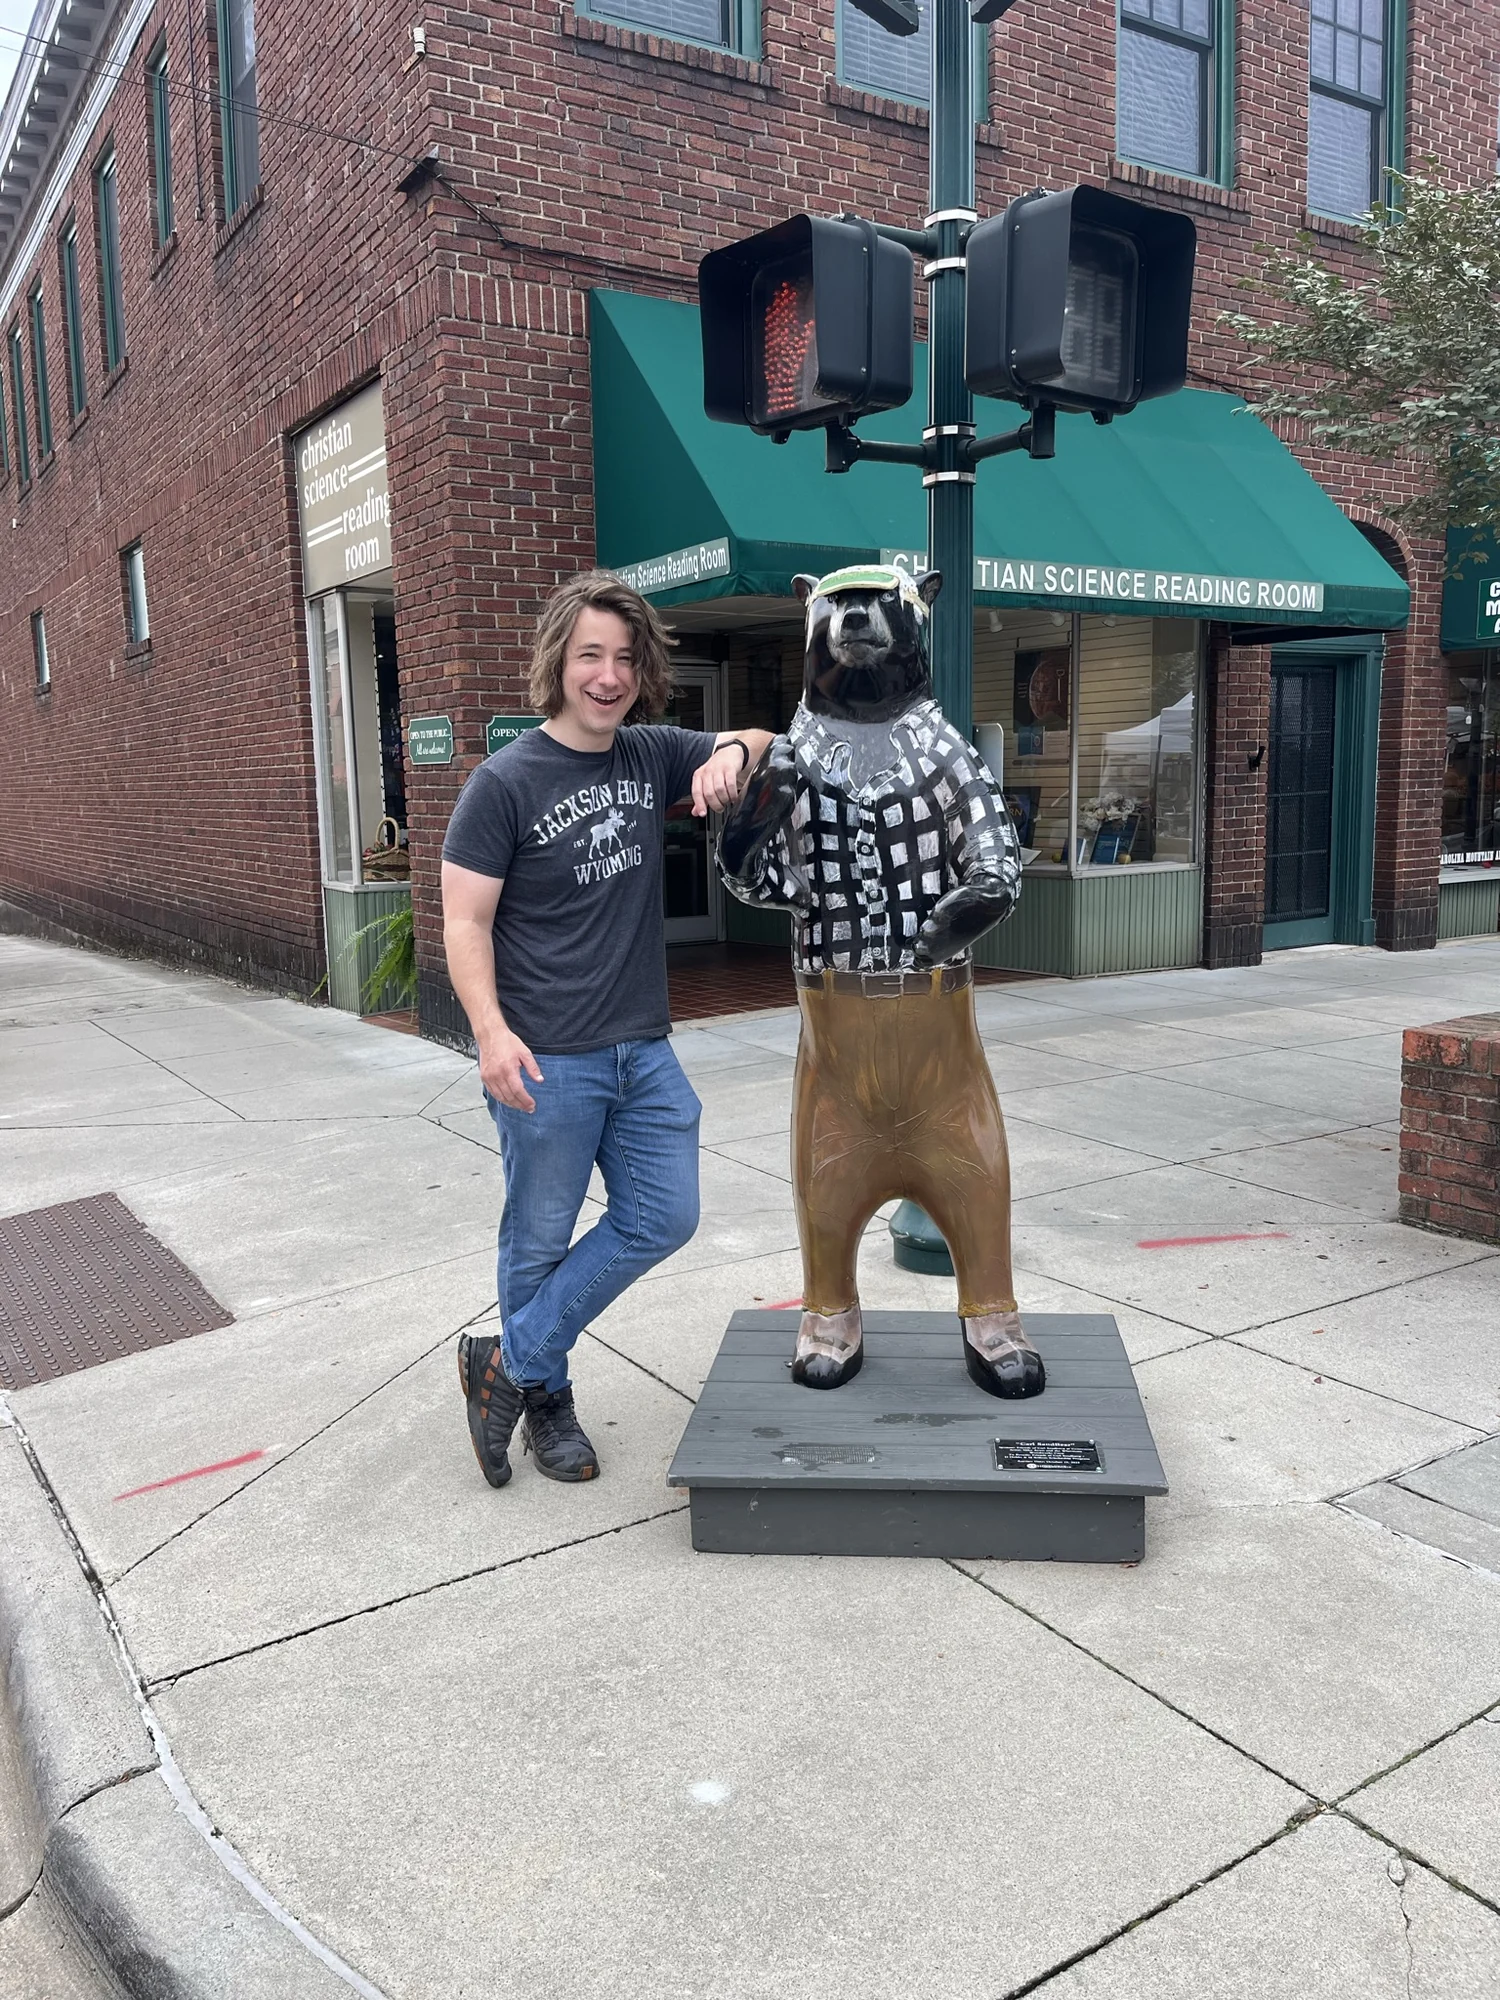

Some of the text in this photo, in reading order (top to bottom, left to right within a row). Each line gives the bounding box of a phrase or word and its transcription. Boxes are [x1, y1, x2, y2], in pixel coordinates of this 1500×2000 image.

[302, 420, 352, 473] christian
[304, 463, 349, 509] science
[342, 486, 392, 535] reading
[345, 536, 380, 572] room
[637, 563, 666, 588] Science
[667, 552, 699, 580] Reading
[700, 546, 727, 572] Room
[893, 553, 1317, 609] CHTIAN SCIENCE READING ROOM
[409, 731, 420, 740] OPEN
[420, 730, 426, 739] TO
[492, 728, 519, 738] OPEN
[533, 783, 614, 845] JACKSON
[573, 845, 642, 886] WYOMING
[1440, 853, 1465, 865] AROLINA
[1465, 850, 1494, 863] MOUNTAIN
